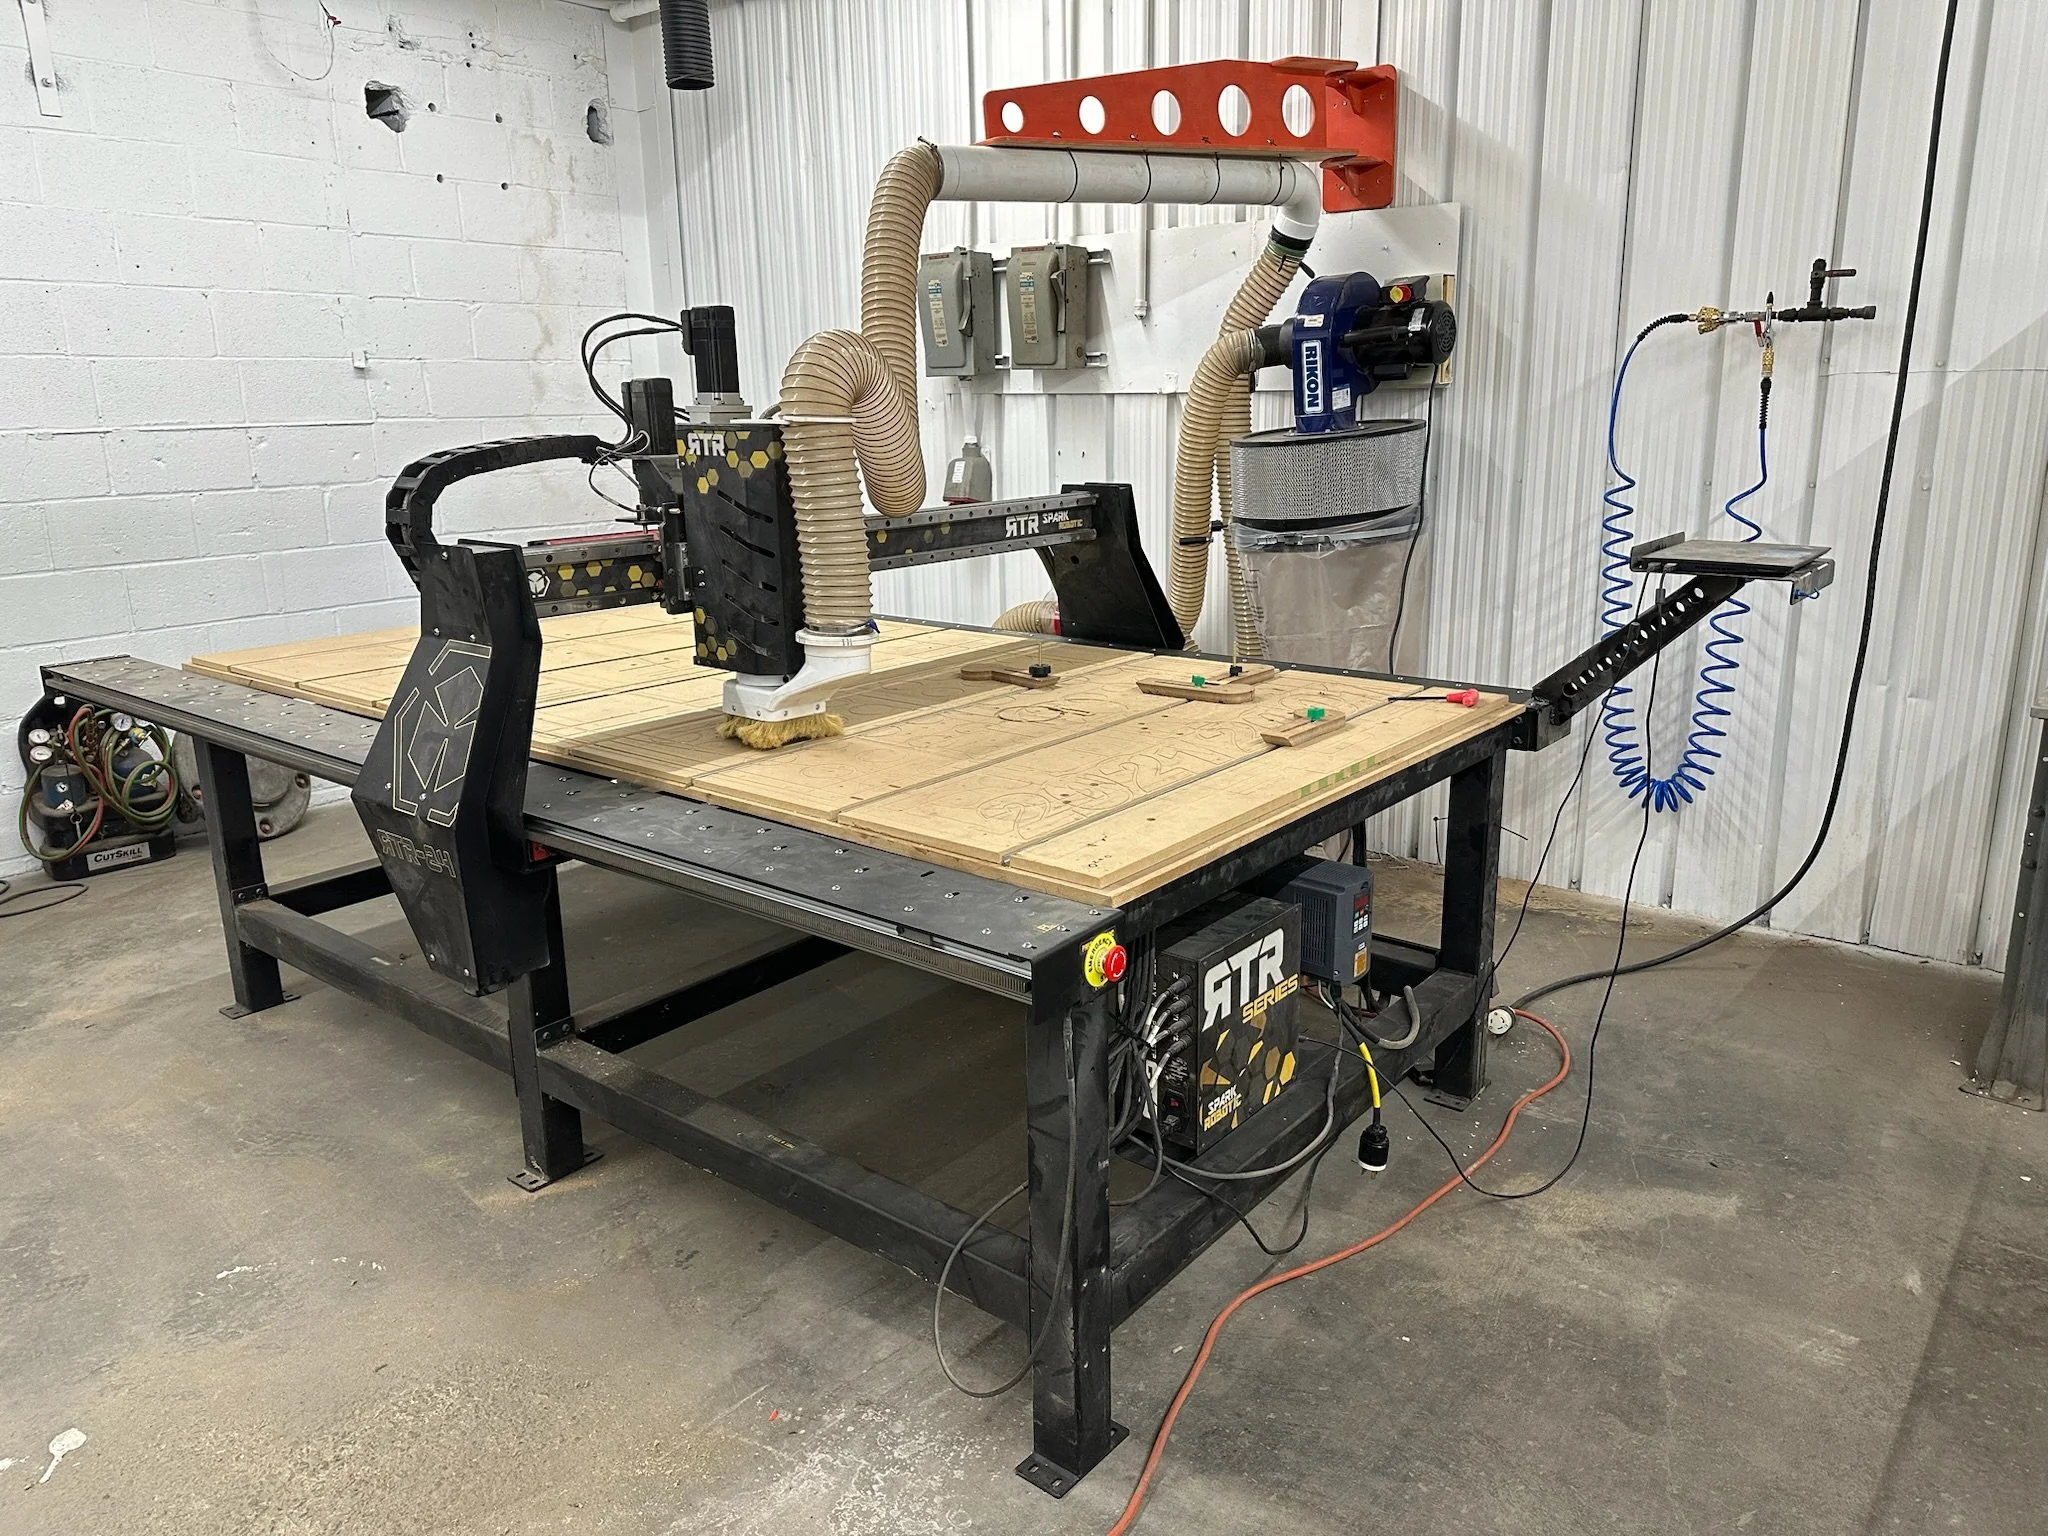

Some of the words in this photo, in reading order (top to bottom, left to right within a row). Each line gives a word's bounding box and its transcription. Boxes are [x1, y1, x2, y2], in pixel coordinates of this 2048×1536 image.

[1305, 346, 1320, 408] RIKON
[1042, 510, 1069, 524] SPARK
[1088, 937, 1112, 973] EMERGENCY
[1242, 973, 1299, 1024] SERIES
[1203, 1093, 1243, 1132] ROBOTIC
[1207, 1084, 1237, 1116] SPARK
